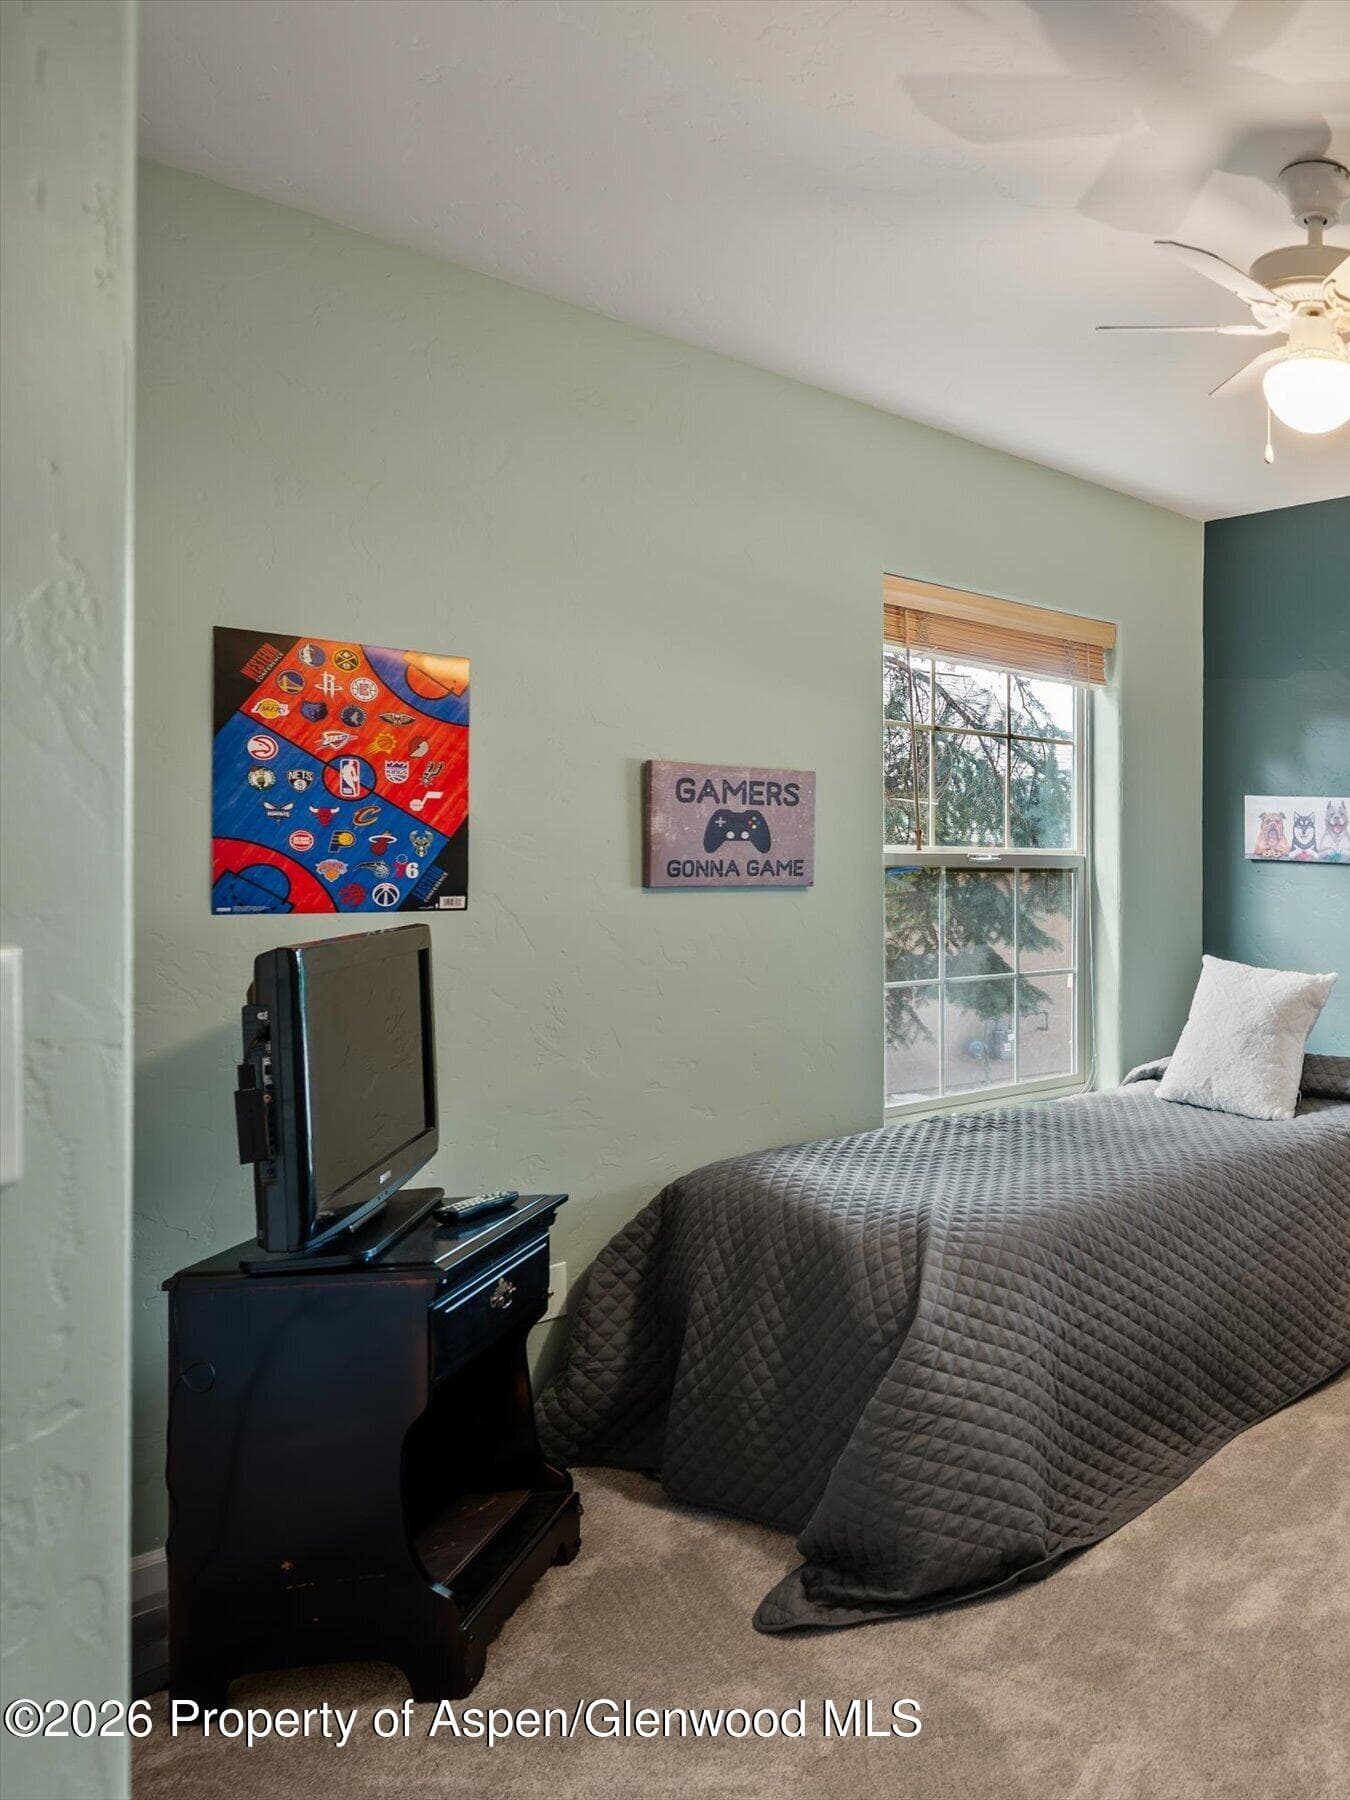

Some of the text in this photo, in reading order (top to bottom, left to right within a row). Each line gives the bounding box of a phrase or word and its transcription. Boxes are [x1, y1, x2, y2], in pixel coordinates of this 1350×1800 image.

[240, 642, 279, 680] WESTERN
[255, 652, 284, 683] CONFERENCE
[287, 770, 314, 781] NETS
[675, 777, 800, 806] GAMERS
[667, 859, 805, 878] GONNA GAME
